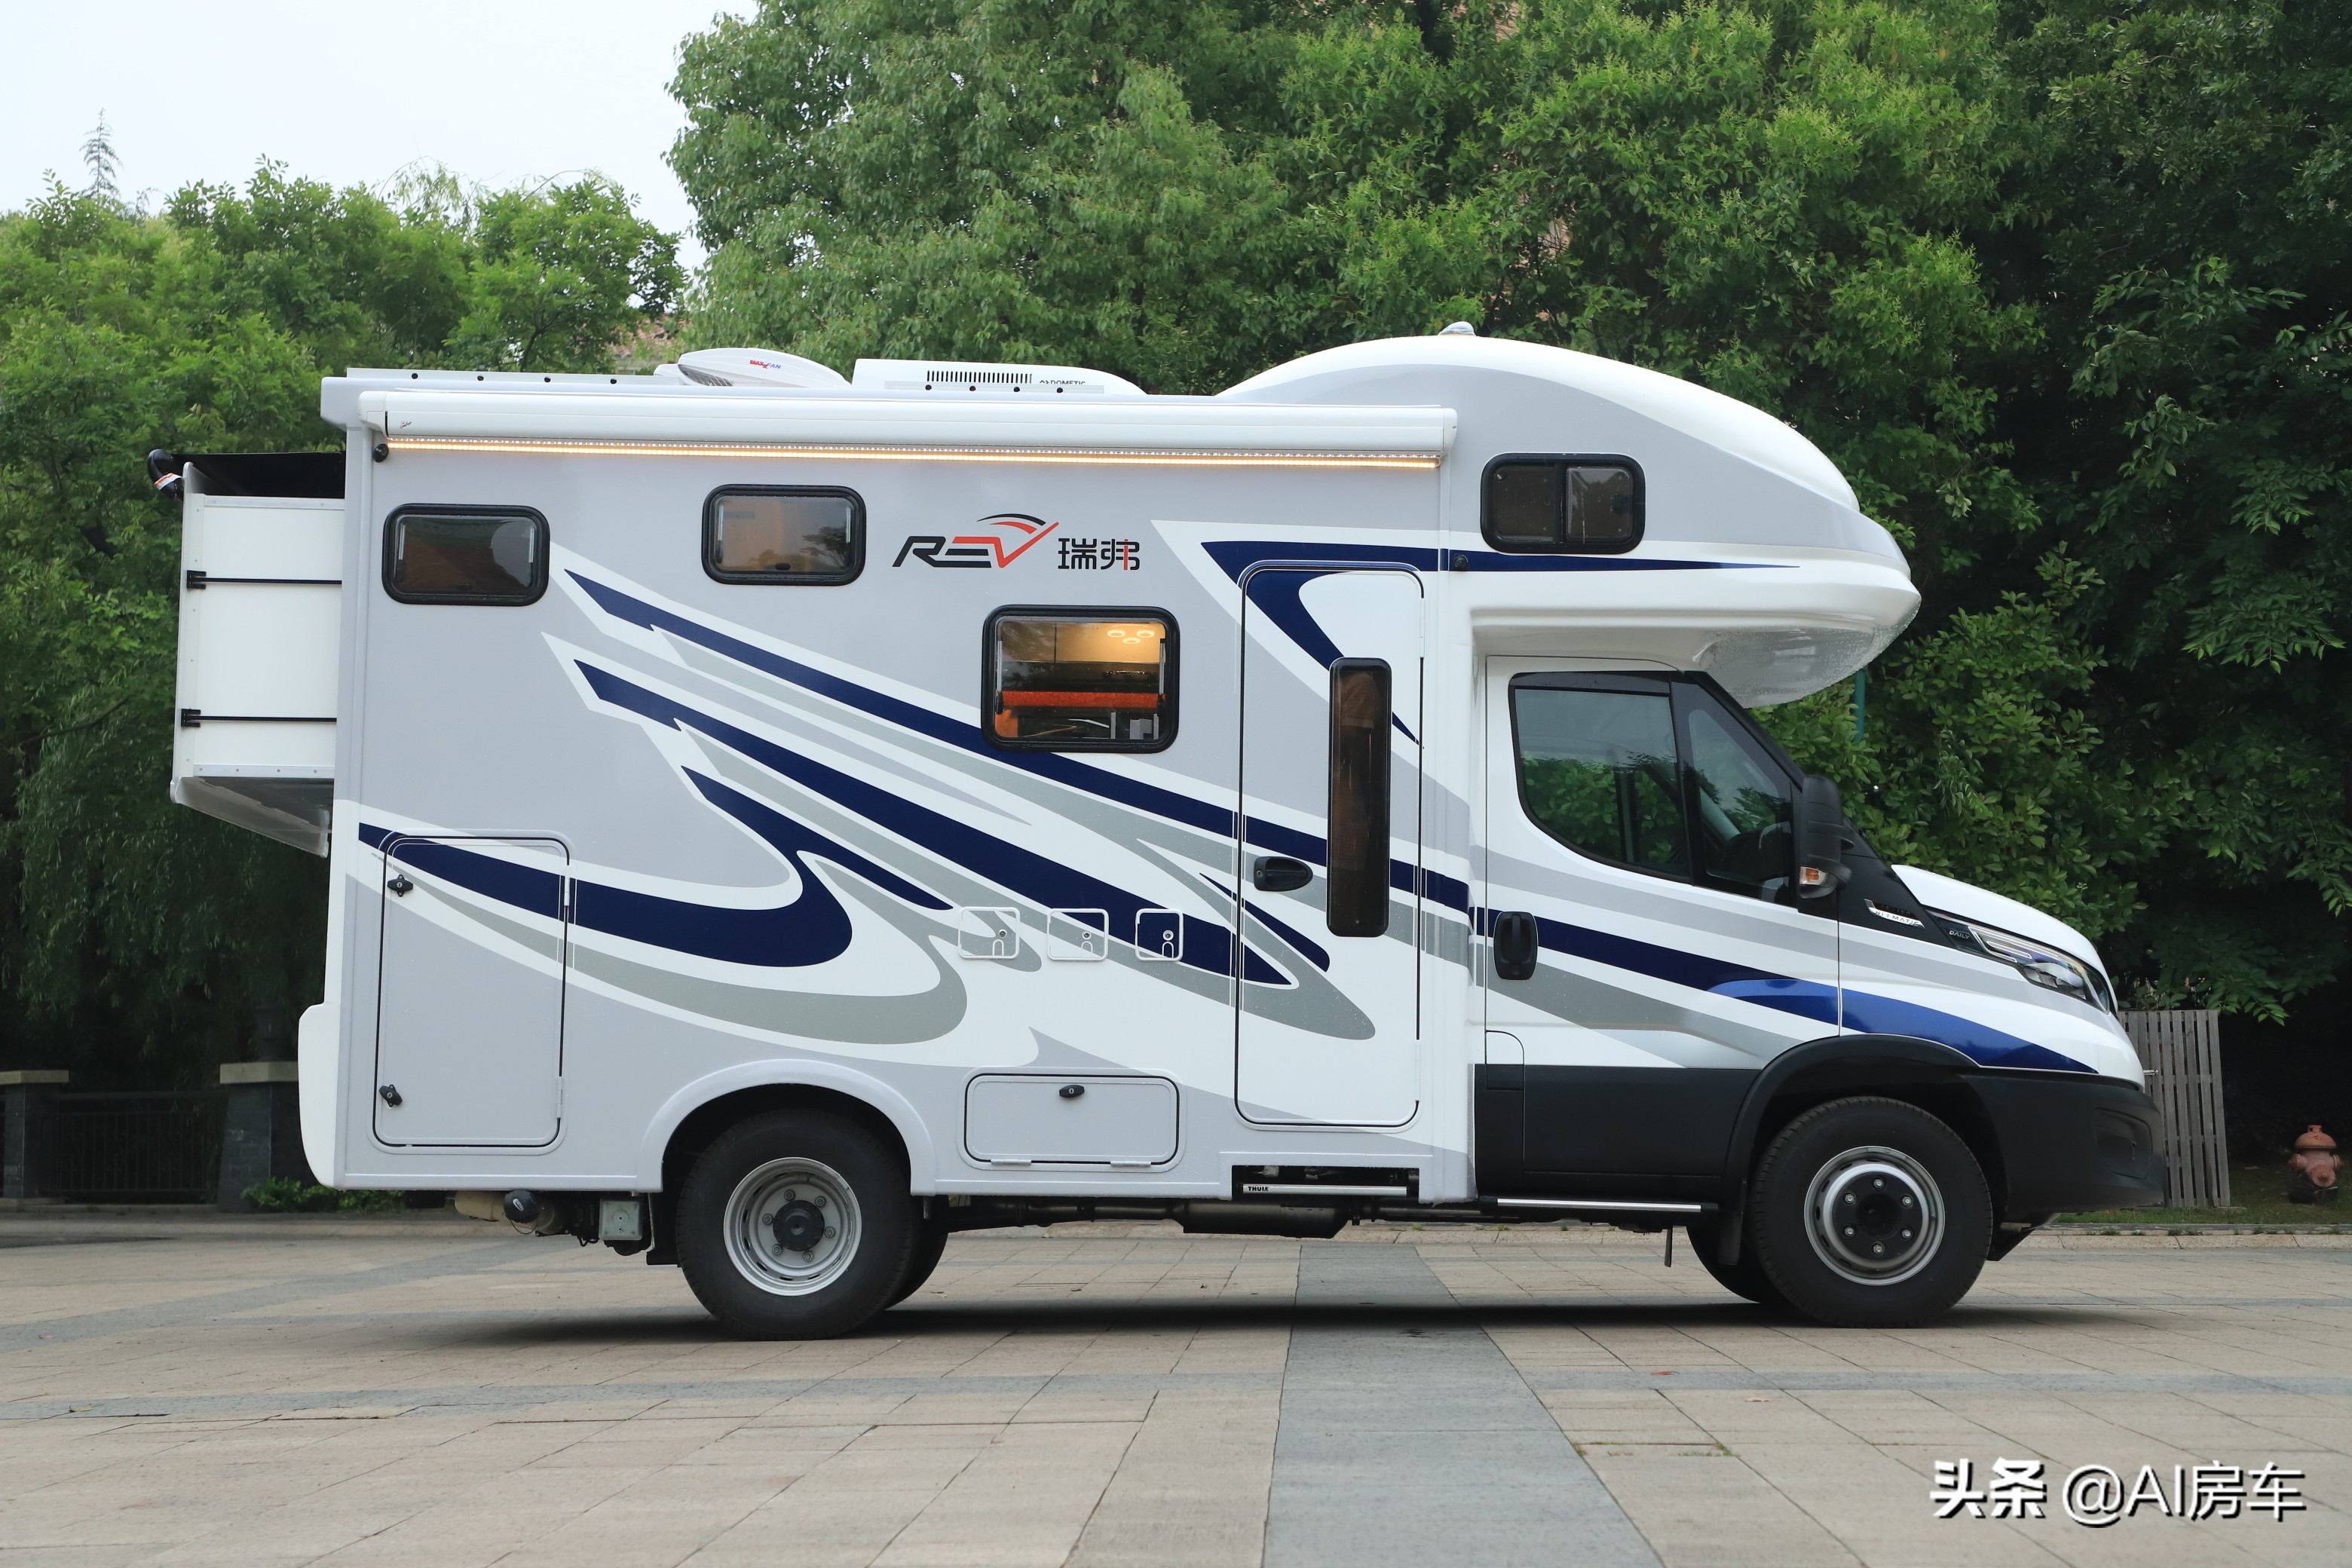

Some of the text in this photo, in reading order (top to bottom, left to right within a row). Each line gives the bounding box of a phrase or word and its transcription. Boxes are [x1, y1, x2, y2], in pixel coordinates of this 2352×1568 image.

[892, 520, 1060, 568] REV
[1057, 537, 1141, 571] 瑞弗
[1949, 929, 1971, 939] DAILY
